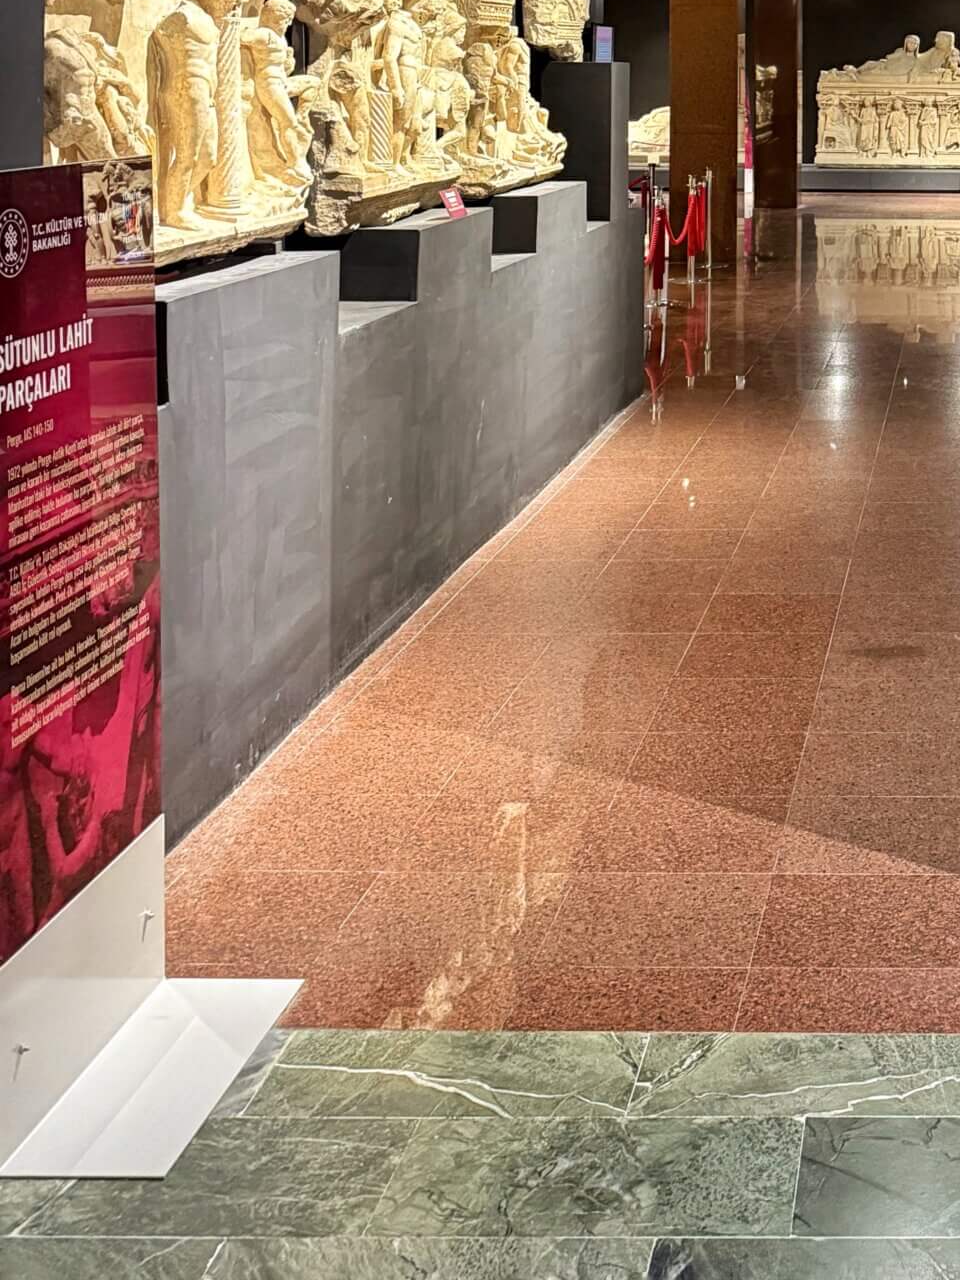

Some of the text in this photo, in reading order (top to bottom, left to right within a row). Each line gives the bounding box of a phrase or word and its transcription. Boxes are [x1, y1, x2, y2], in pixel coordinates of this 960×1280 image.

[32, 224, 45, 236] T.C.
[46, 218, 73, 233] KÜLTÜR
[74, 218, 83, 228] VE
[32, 234, 71, 253] BAKANLIĞI
[59, 313, 94, 353] LAHİT
[0, 363, 71, 415] PARÇALARI
[24, 427, 32, 441] MS
[33, 418, 54, 437] 140-150
[7, 464, 20, 481] 1972
